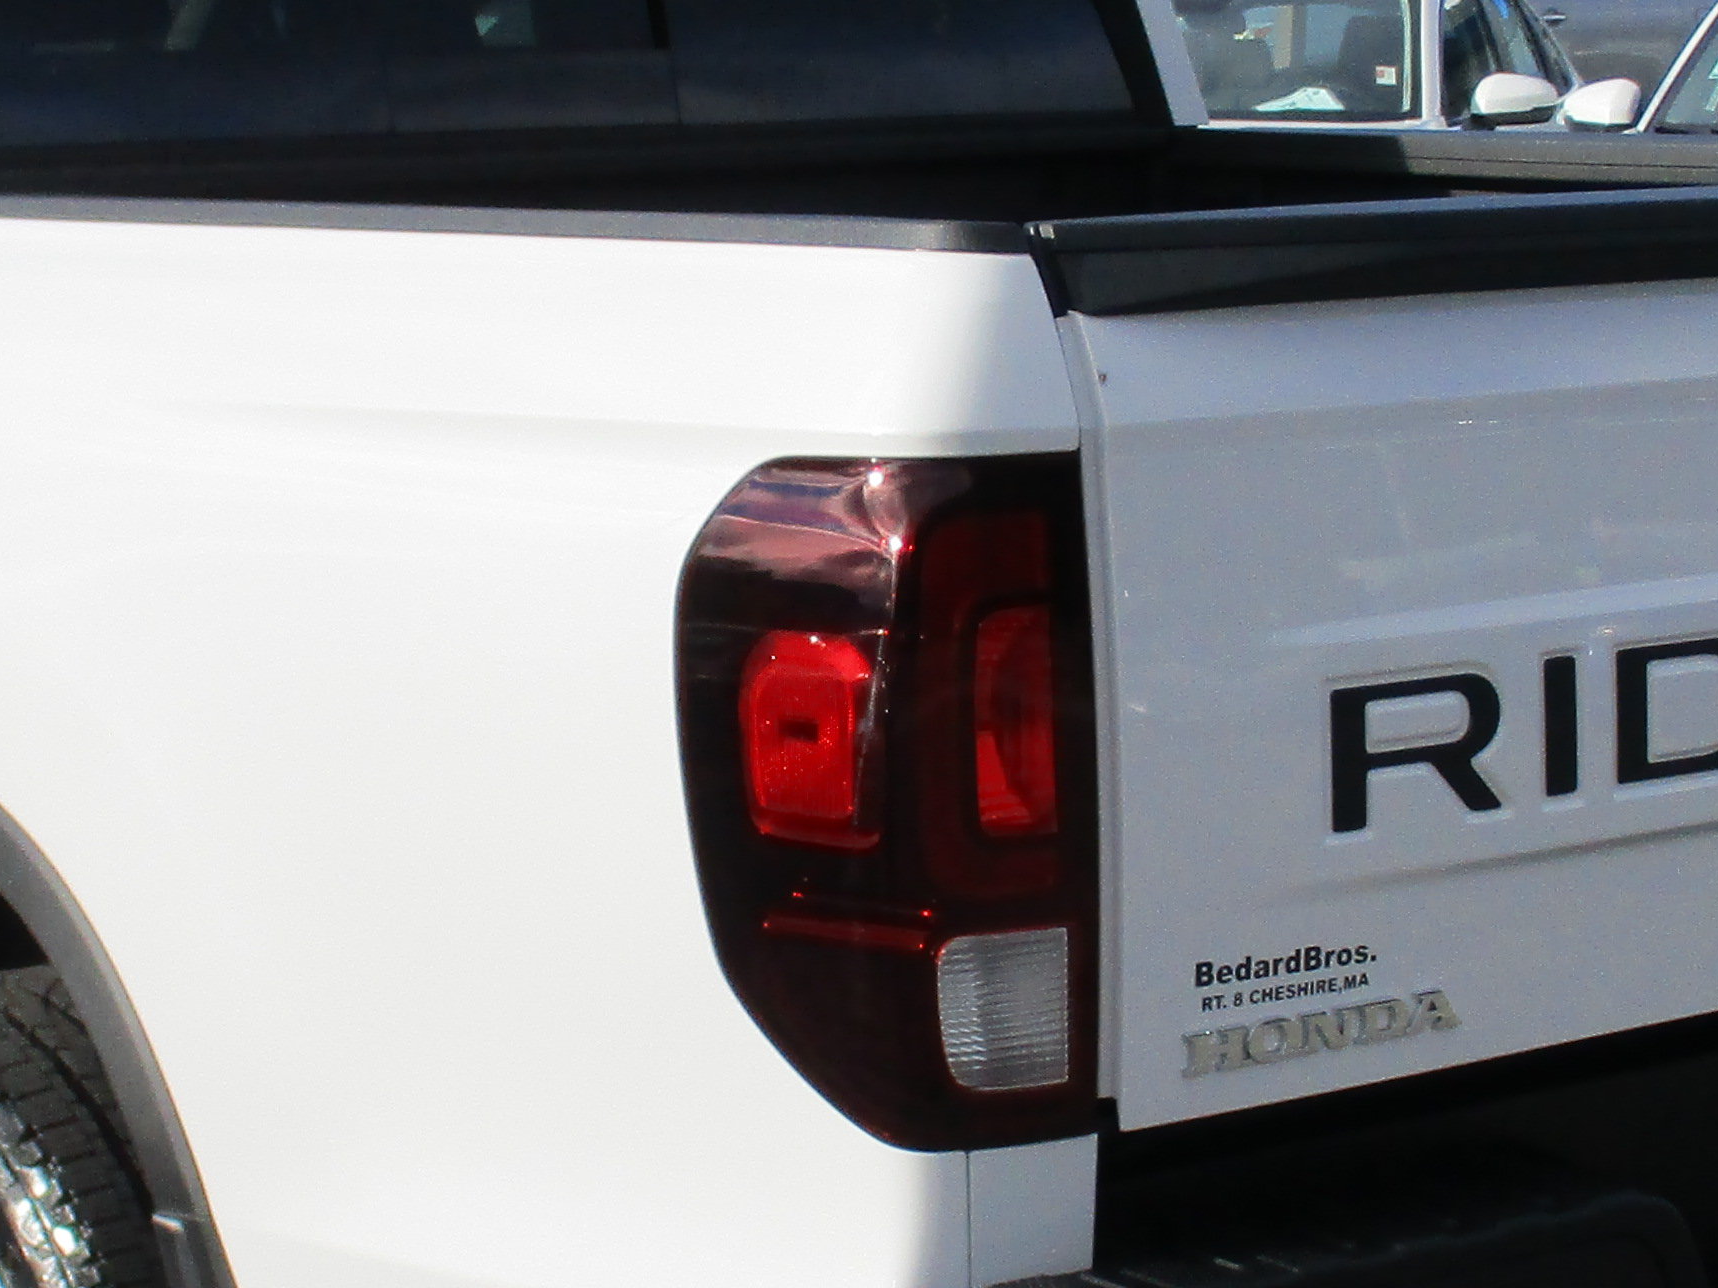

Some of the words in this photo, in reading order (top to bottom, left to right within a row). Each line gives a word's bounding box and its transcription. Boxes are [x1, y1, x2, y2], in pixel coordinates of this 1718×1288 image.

[1201, 994, 1227, 1012] RT.
[1234, 992, 1243, 1008] 8
[1181, 989, 1463, 1079] HONDA
